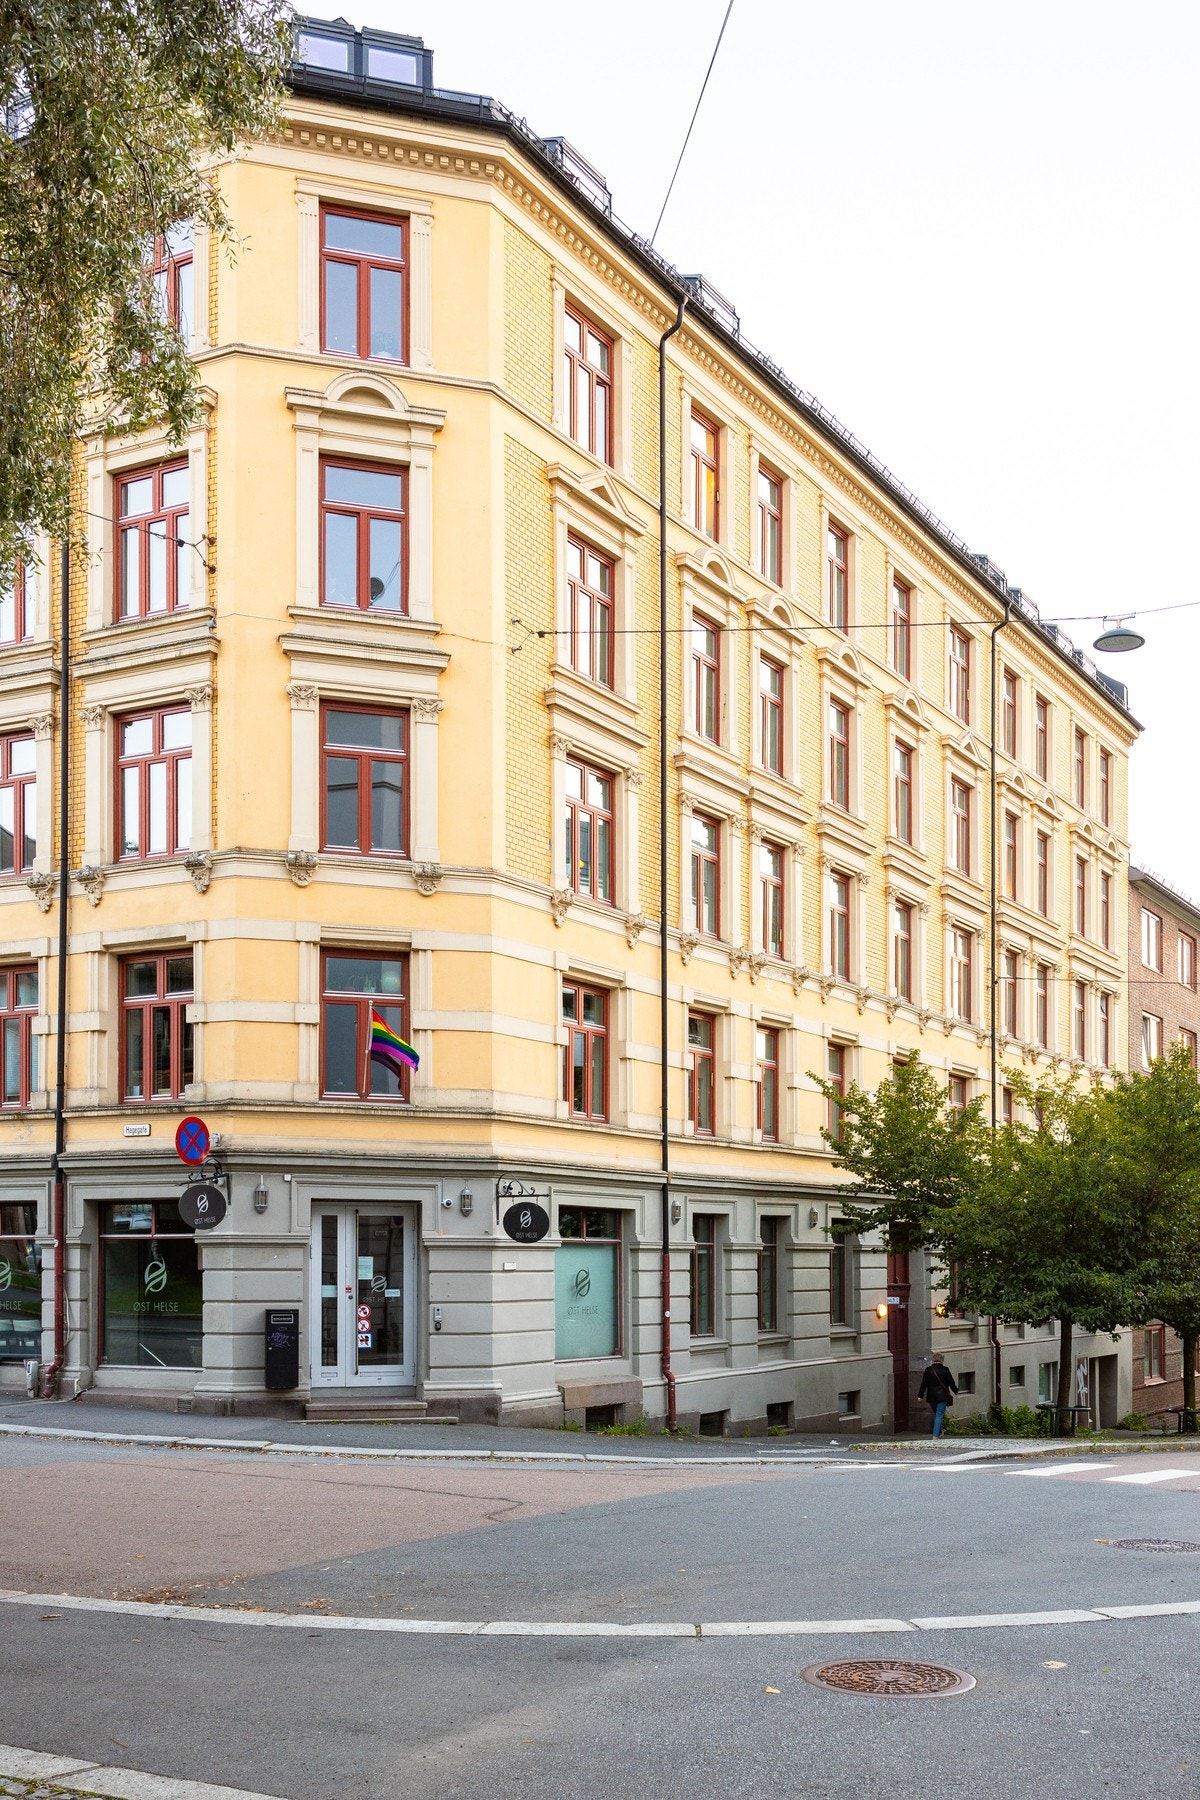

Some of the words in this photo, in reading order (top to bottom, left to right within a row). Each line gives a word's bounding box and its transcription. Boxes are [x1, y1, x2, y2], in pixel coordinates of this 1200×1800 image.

[133, 1301, 151, 1312] ØST
[153, 1301, 179, 1312] HELSE
[567, 1305, 580, 1315] ØST
[582, 1305, 599, 1315] HELSE
